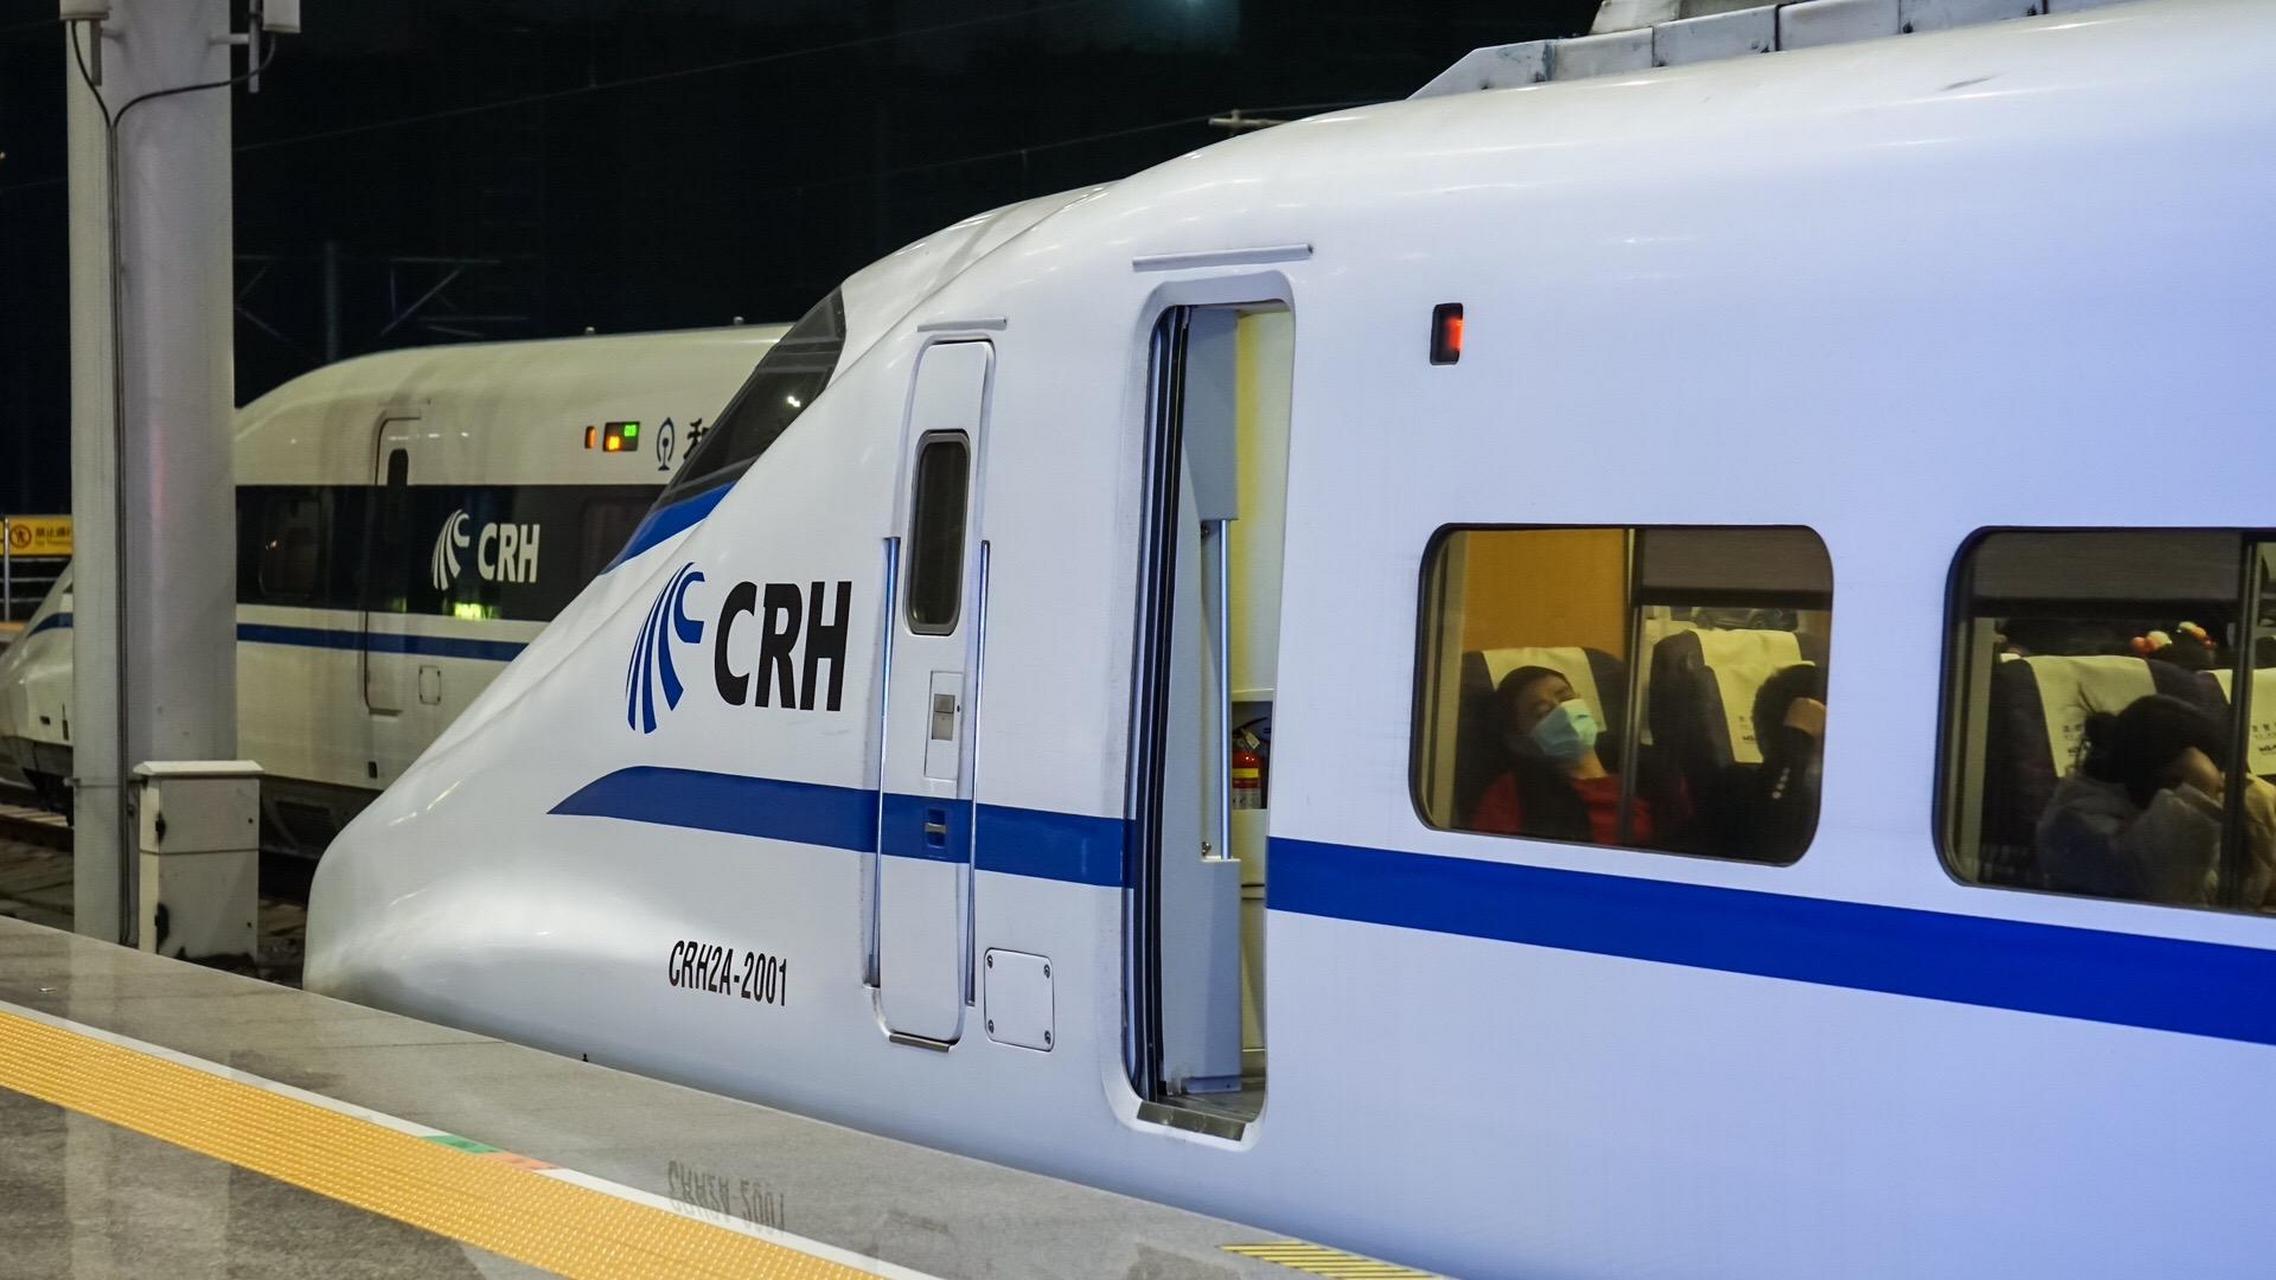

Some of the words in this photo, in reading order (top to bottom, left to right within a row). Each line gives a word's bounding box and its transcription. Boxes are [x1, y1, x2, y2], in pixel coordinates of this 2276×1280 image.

[477, 523, 541, 584] CRH
[714, 580, 853, 712] CRH
[668, 940, 787, 1007] CRH2A-2001
